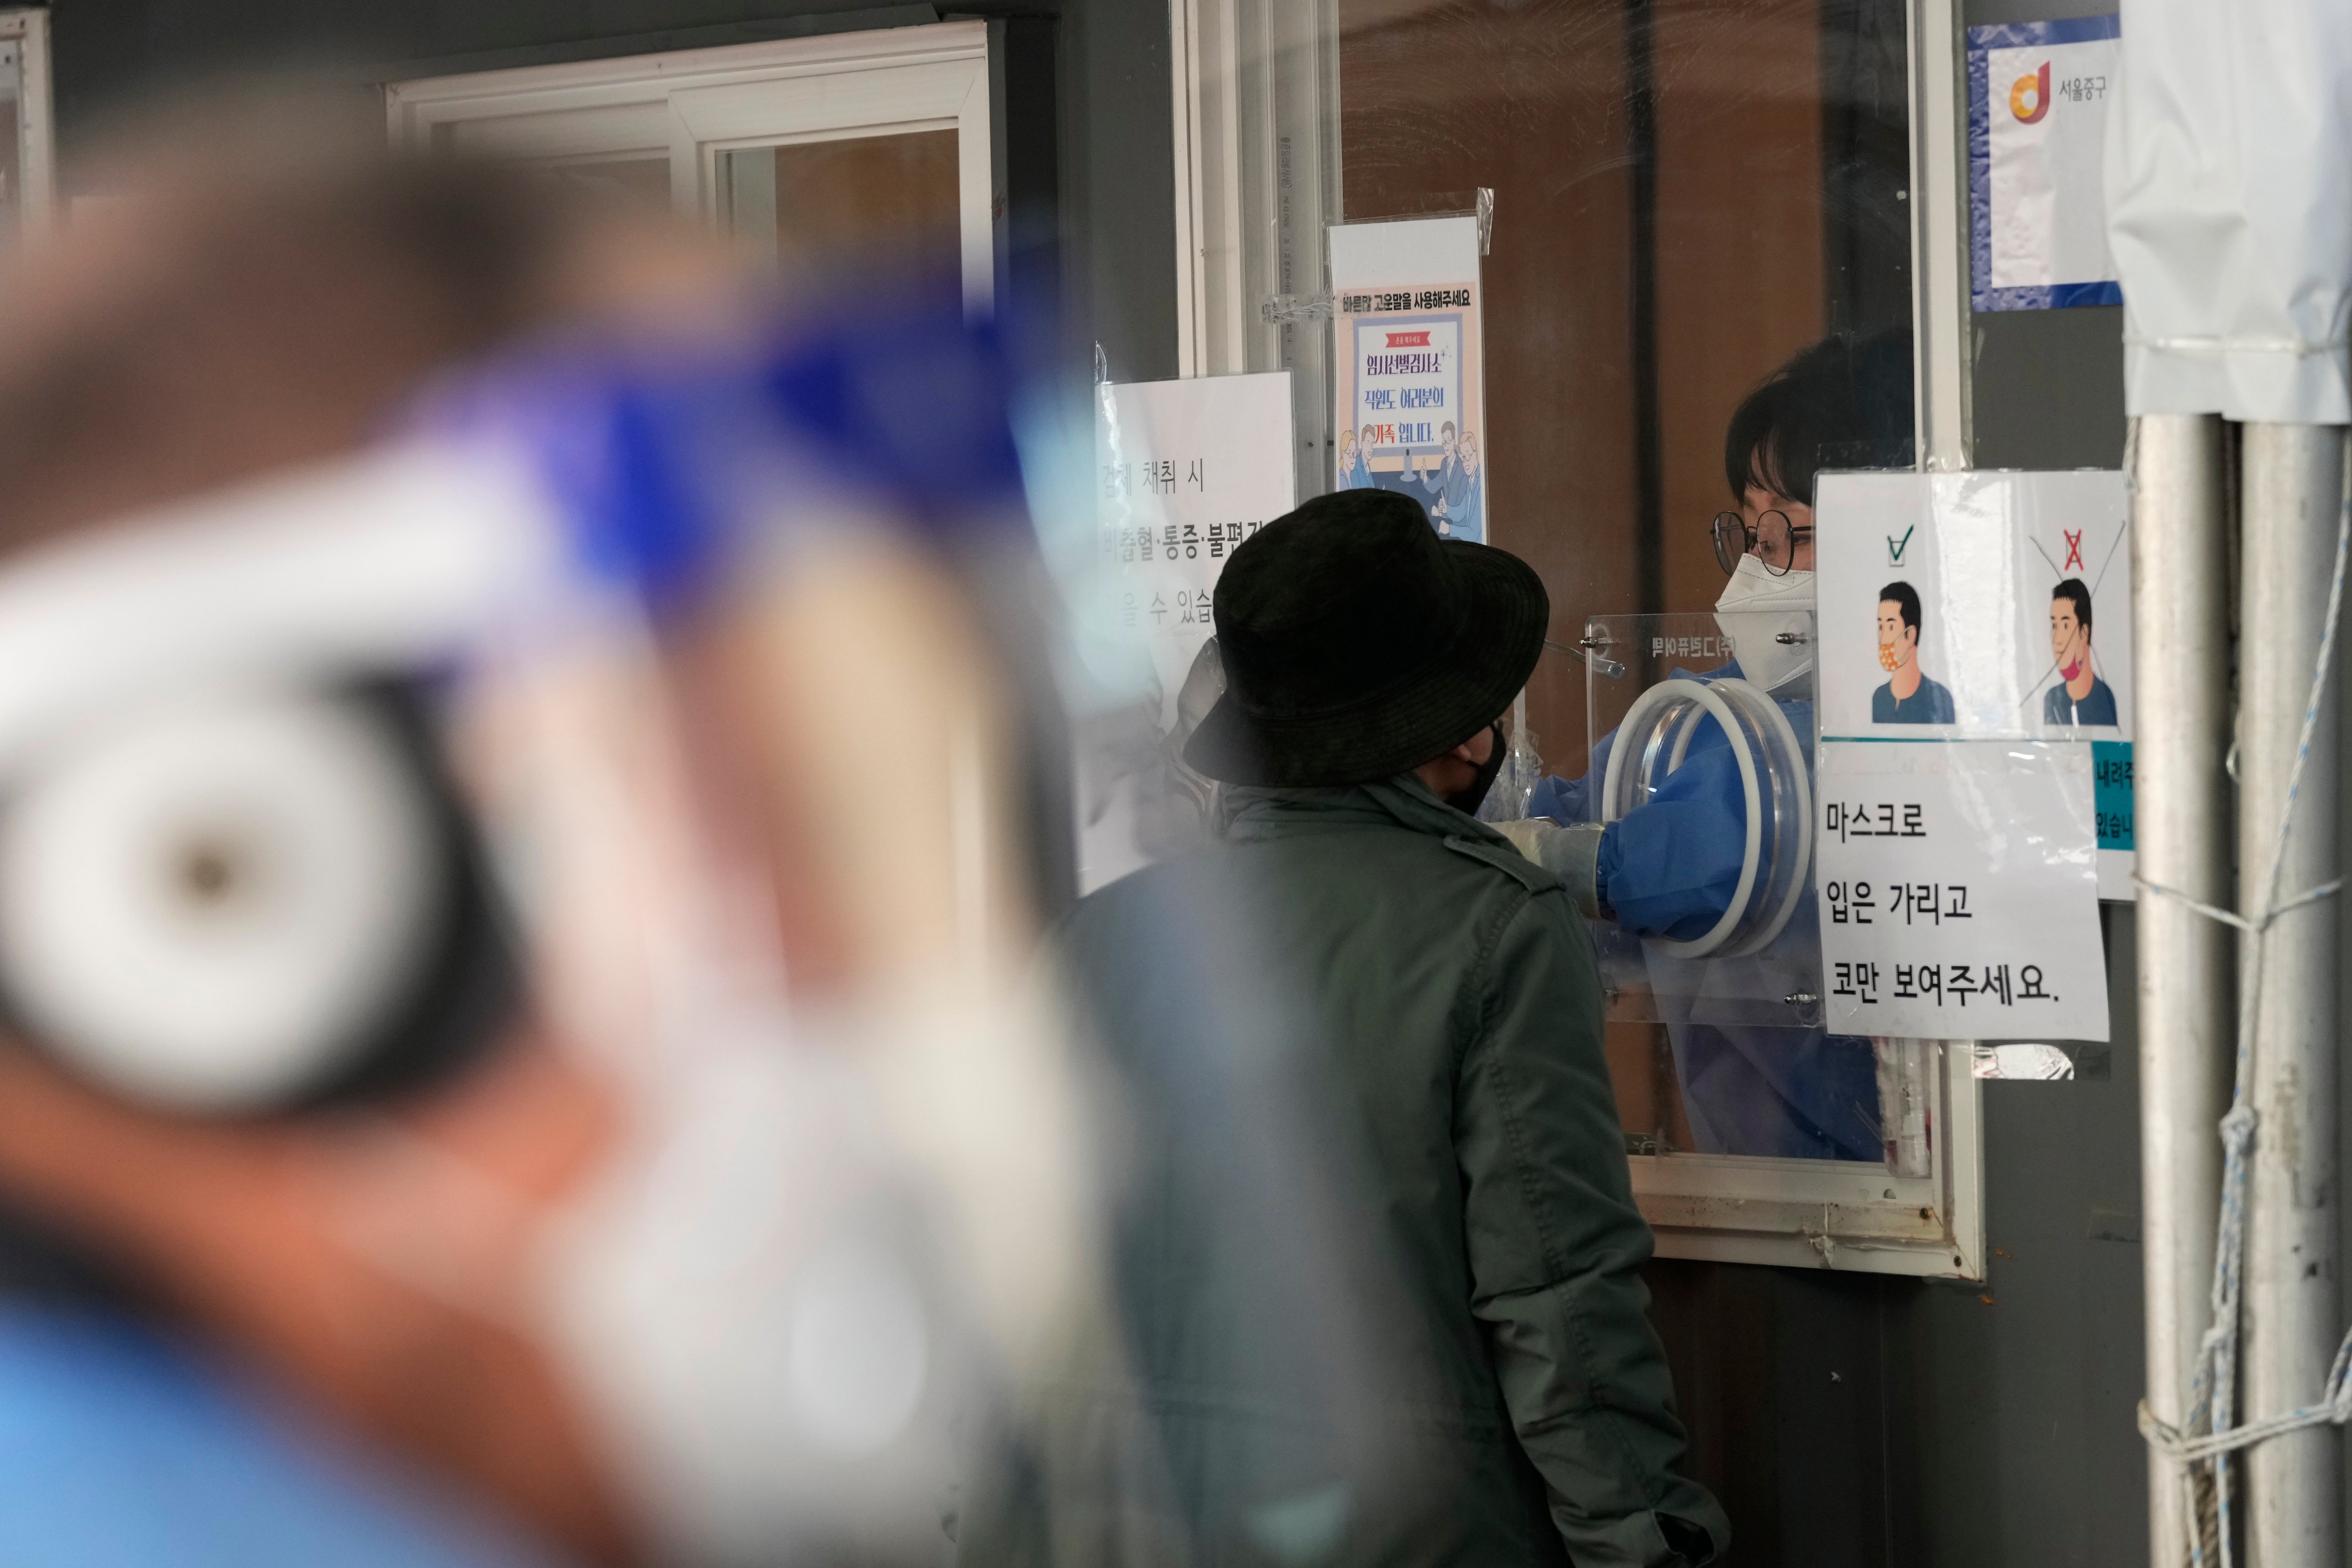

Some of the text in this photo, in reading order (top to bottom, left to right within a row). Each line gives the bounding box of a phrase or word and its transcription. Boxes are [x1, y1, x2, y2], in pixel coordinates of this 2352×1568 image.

[2059, 76, 2106, 102] 서울중구
[1374, 292, 1411, 311] 고운말을
[1414, 289, 1471, 309] 사용해주세요
[1367, 353, 1442, 375] 임시선별검사소
[1365, 386, 1443, 410] 직원도 여러분의
[1374, 422, 1433, 444] 가족 입니다.
[1143, 460, 1175, 495] 채취
[1188, 458, 1203, 492] 시
[1150, 592, 1167, 625] 수
[1827, 802, 1926, 843] 마스크로
[1827, 881, 1972, 925] 입은 가리고
[1833, 962, 2060, 1007] 코만 보여주세요.
